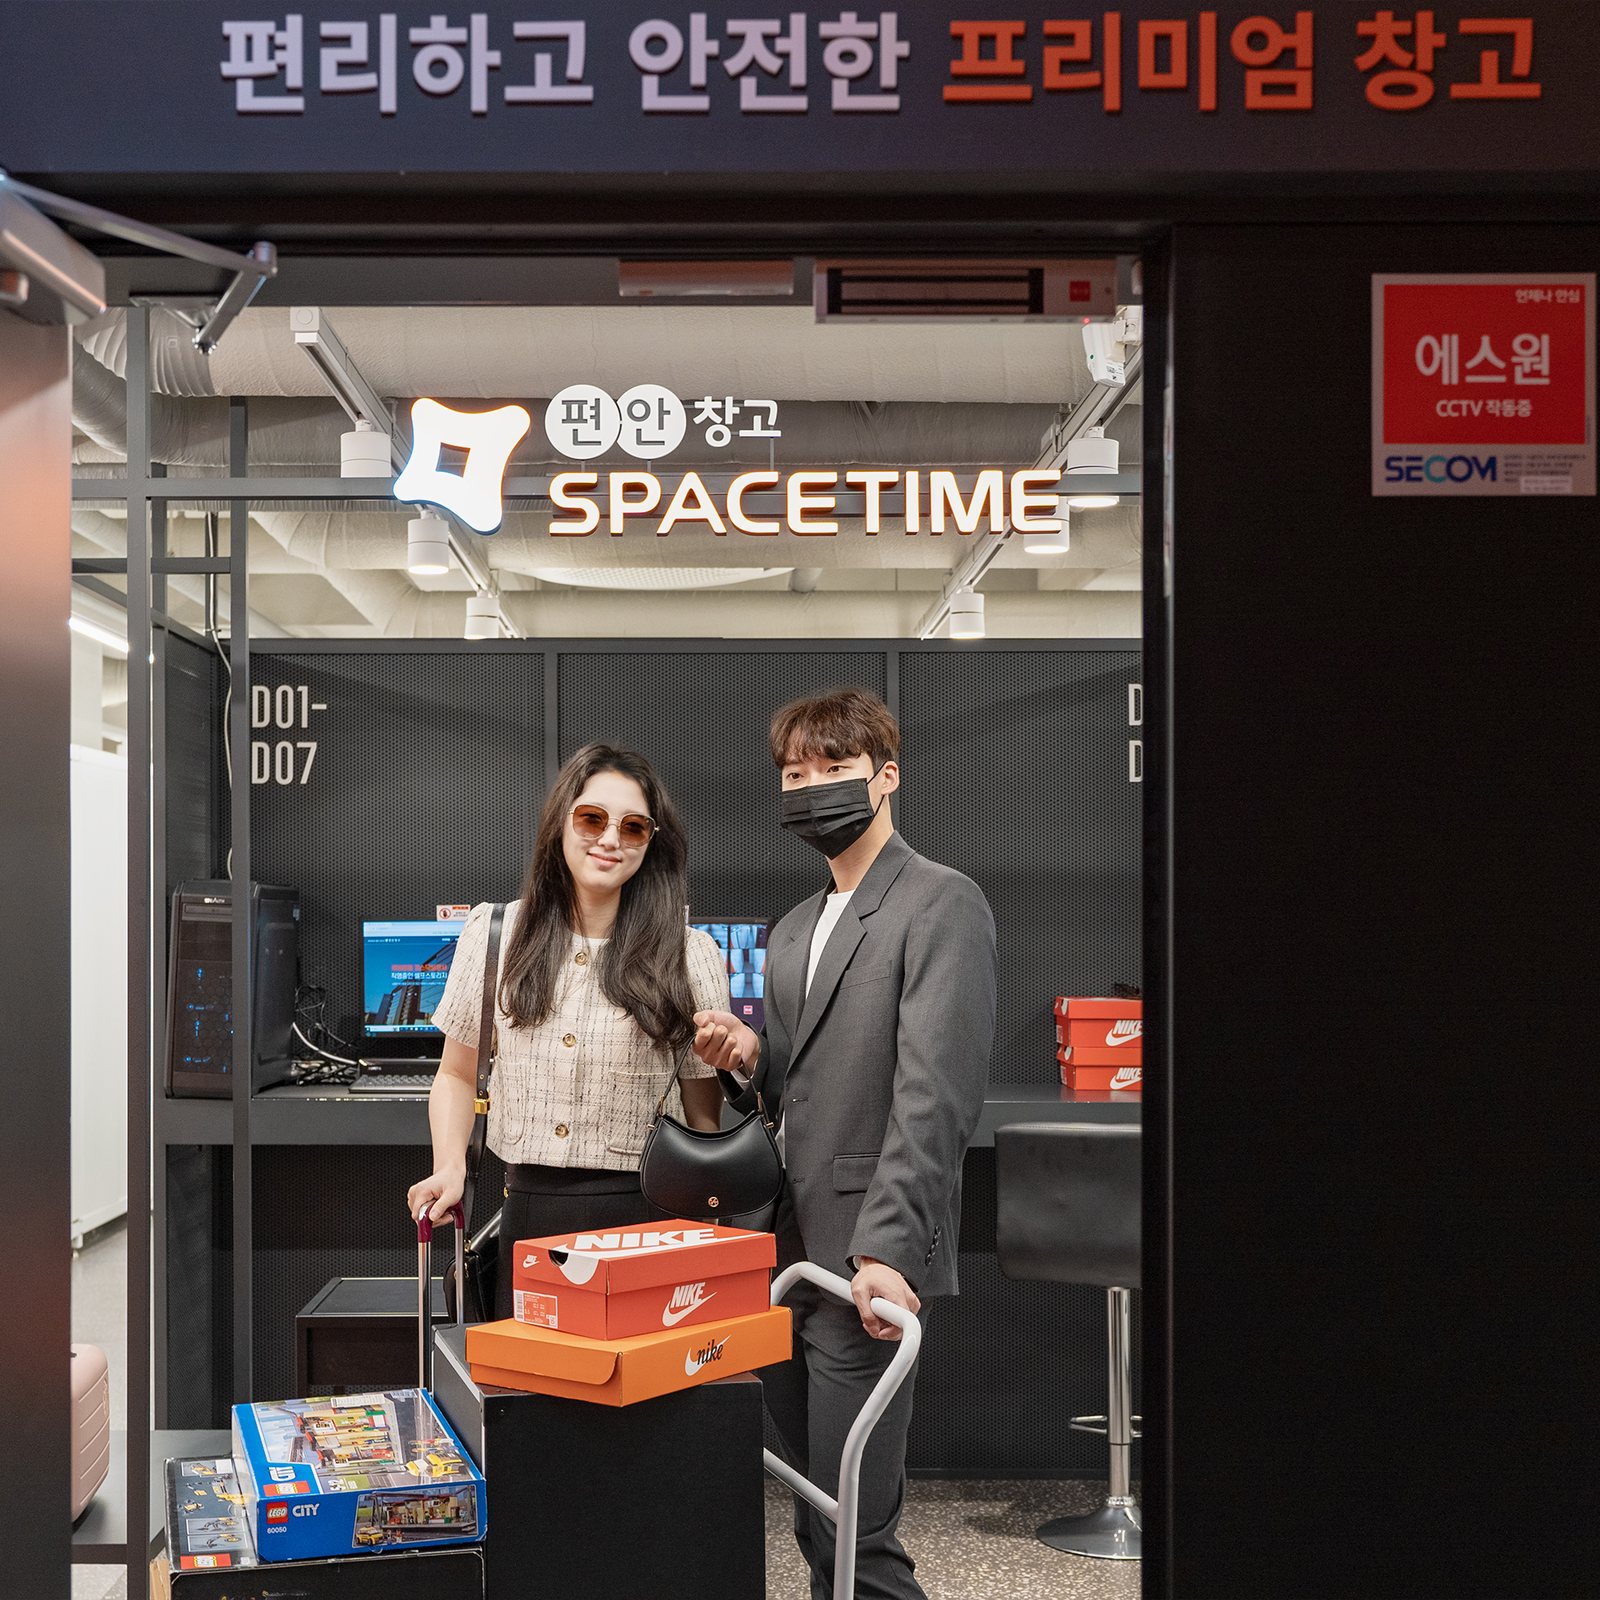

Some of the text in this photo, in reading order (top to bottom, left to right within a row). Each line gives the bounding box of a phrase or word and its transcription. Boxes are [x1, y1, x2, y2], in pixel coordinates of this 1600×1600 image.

[221, 11, 1542, 114] 편리하고 안전한 프리미엄 창고
[1415, 333, 1551, 385] 에스원
[1436, 399, 1532, 417] CCTV 작동중
[1385, 455, 1497, 483] SECOM
[549, 470, 1062, 536] SPACETIME
[252, 741, 317, 785] D07
[573, 1228, 718, 1250] NIKE
[670, 1282, 705, 1308] NIKE
[697, 1339, 723, 1365] nike
[267, 1503, 320, 1518] LEGO CITY
